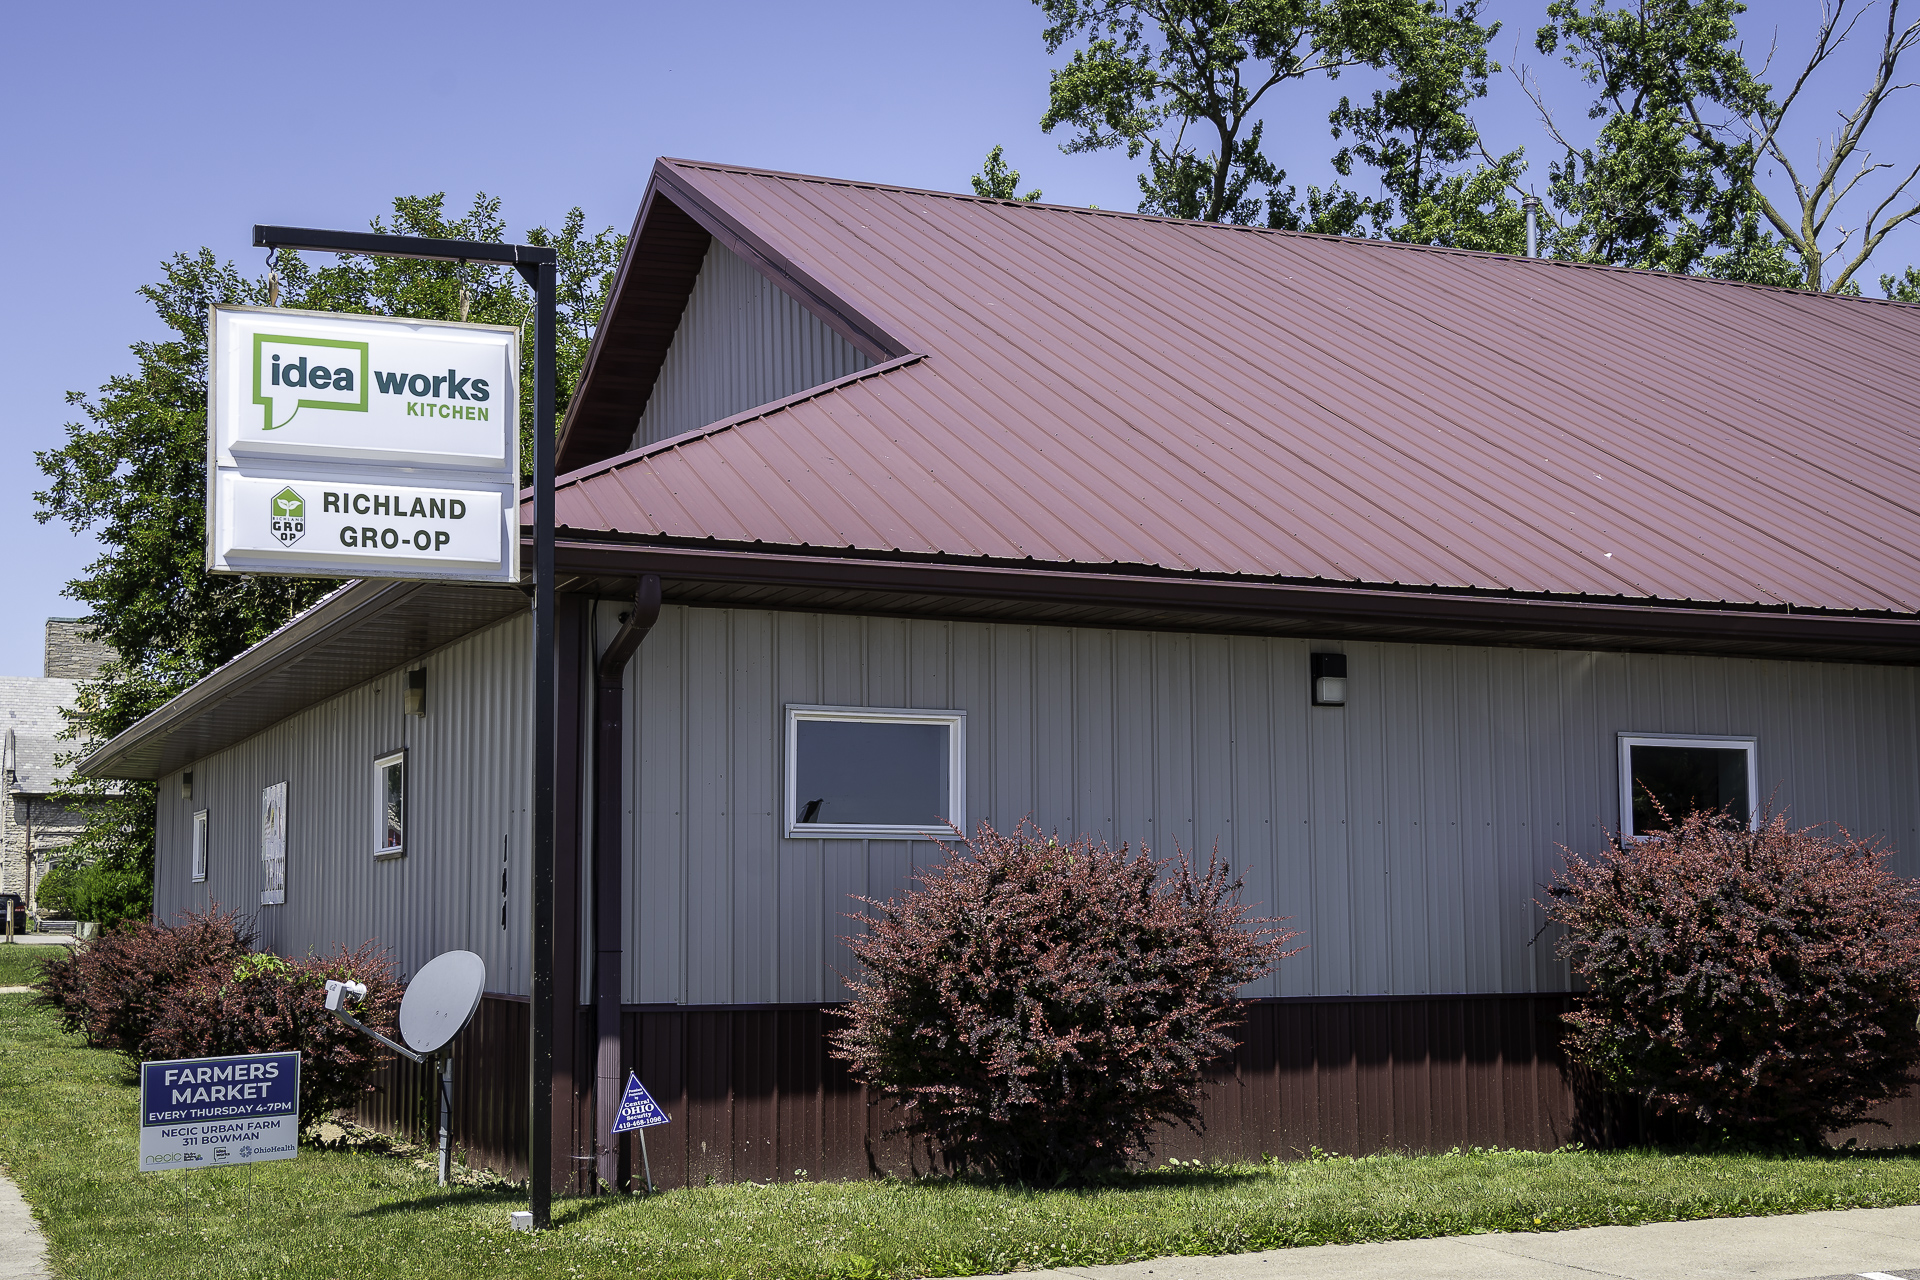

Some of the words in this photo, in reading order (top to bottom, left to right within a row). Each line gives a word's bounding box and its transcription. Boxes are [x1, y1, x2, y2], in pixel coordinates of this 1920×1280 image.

[271, 353, 354, 392] idea
[373, 368, 490, 402] works
[406, 401, 489, 422] KITCHEN
[323, 491, 466, 520] RICHLAND
[272, 521, 304, 532] GRO
[280, 532, 296, 541] OP
[339, 525, 451, 552] GRO-OP
[164, 1061, 280, 1086] FARMERS
[171, 1081, 272, 1105] MARKET
[149, 1109, 188, 1121] EVERY
[190, 1104, 253, 1118] THURSDAY
[255, 1101, 292, 1112] 4-7PM
[621, 1103, 655, 1116] OHIO
[624, 1098, 649, 1107] Central
[626, 1112, 651, 1120] Security
[161, 1126, 198, 1138] NECIC
[201, 1122, 244, 1135] URBAN
[247, 1119, 281, 1131] FARM
[182, 1137, 198, 1147] 311
[201, 1131, 260, 1145] BOWMAN
[145, 1151, 182, 1164] necic
[253, 1144, 296, 1154] OhioHealth
